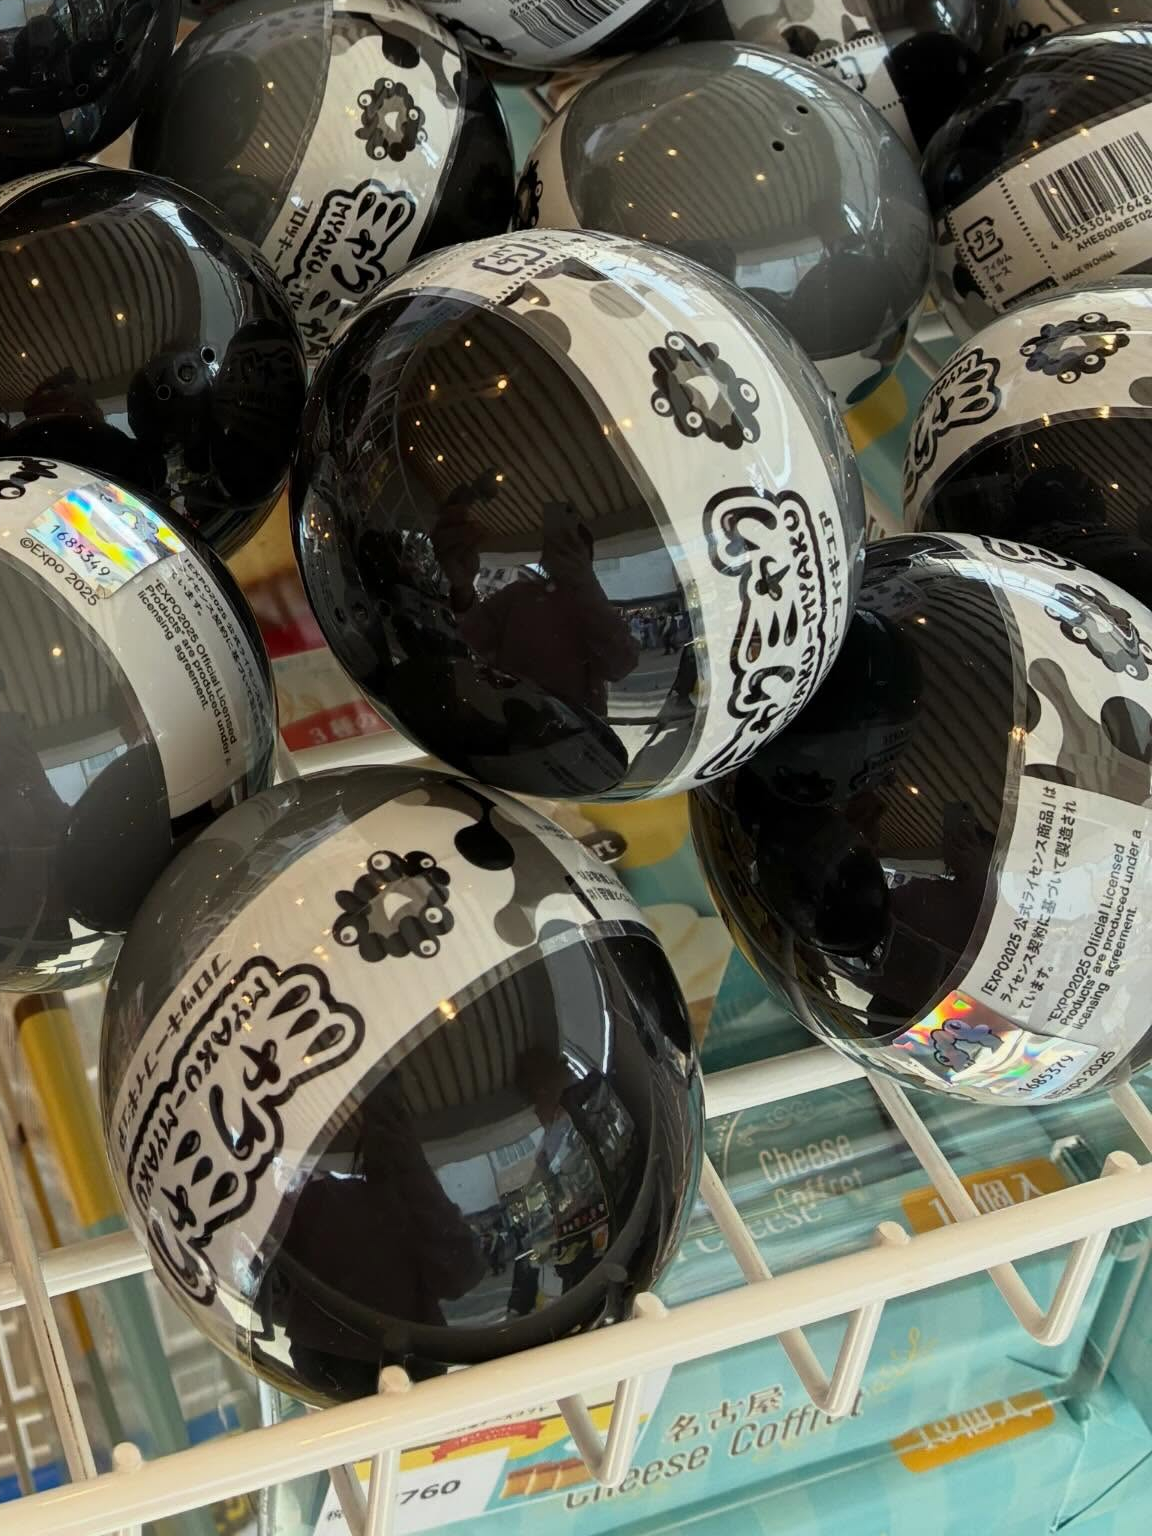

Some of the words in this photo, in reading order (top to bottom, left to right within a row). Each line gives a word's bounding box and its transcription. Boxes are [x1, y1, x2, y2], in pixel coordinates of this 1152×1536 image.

[274, 199, 314, 273] フロッキー
[1064, 215, 1113, 243] 535304
[1061, 268, 1084, 282] MADE
[1092, 250, 1117, 267] CHINA
[49, 524, 111, 577] 1685349
[64, 572, 99, 607] 2025
[138, 590, 174, 641] licensing
[174, 644, 209, 711] agreement.
[182, 637, 196, 657] are
[192, 657, 222, 718] produced
[196, 641, 220, 688] Official
[215, 687, 238, 746] Licensed
[981, 933, 1023, 997] 「EXPO2025
[1015, 786, 1058, 934] 公式ライセンス商品」は
[999, 800, 1078, 1003] ライセンス契約に基づいて製造され
[1083, 908, 1108, 957] Official
[1100, 842, 1126, 910] Licensed
[1094, 949, 1108, 974] are
[1102, 886, 1130, 951] produced
[1124, 840, 1140, 887] under
[1132, 828, 1143, 840] a
[1018, 966, 1055, 1012] ています。
[1072, 981, 1109, 1031] licensing
[1104, 905, 1139, 978] agreement.
[1079, 1049, 1116, 1082] 2025
[758, 1134, 854, 1185] Cheese
[928, 1172, 1044, 1226] 1個入
[667, 1386, 785, 1443] 名古屋
